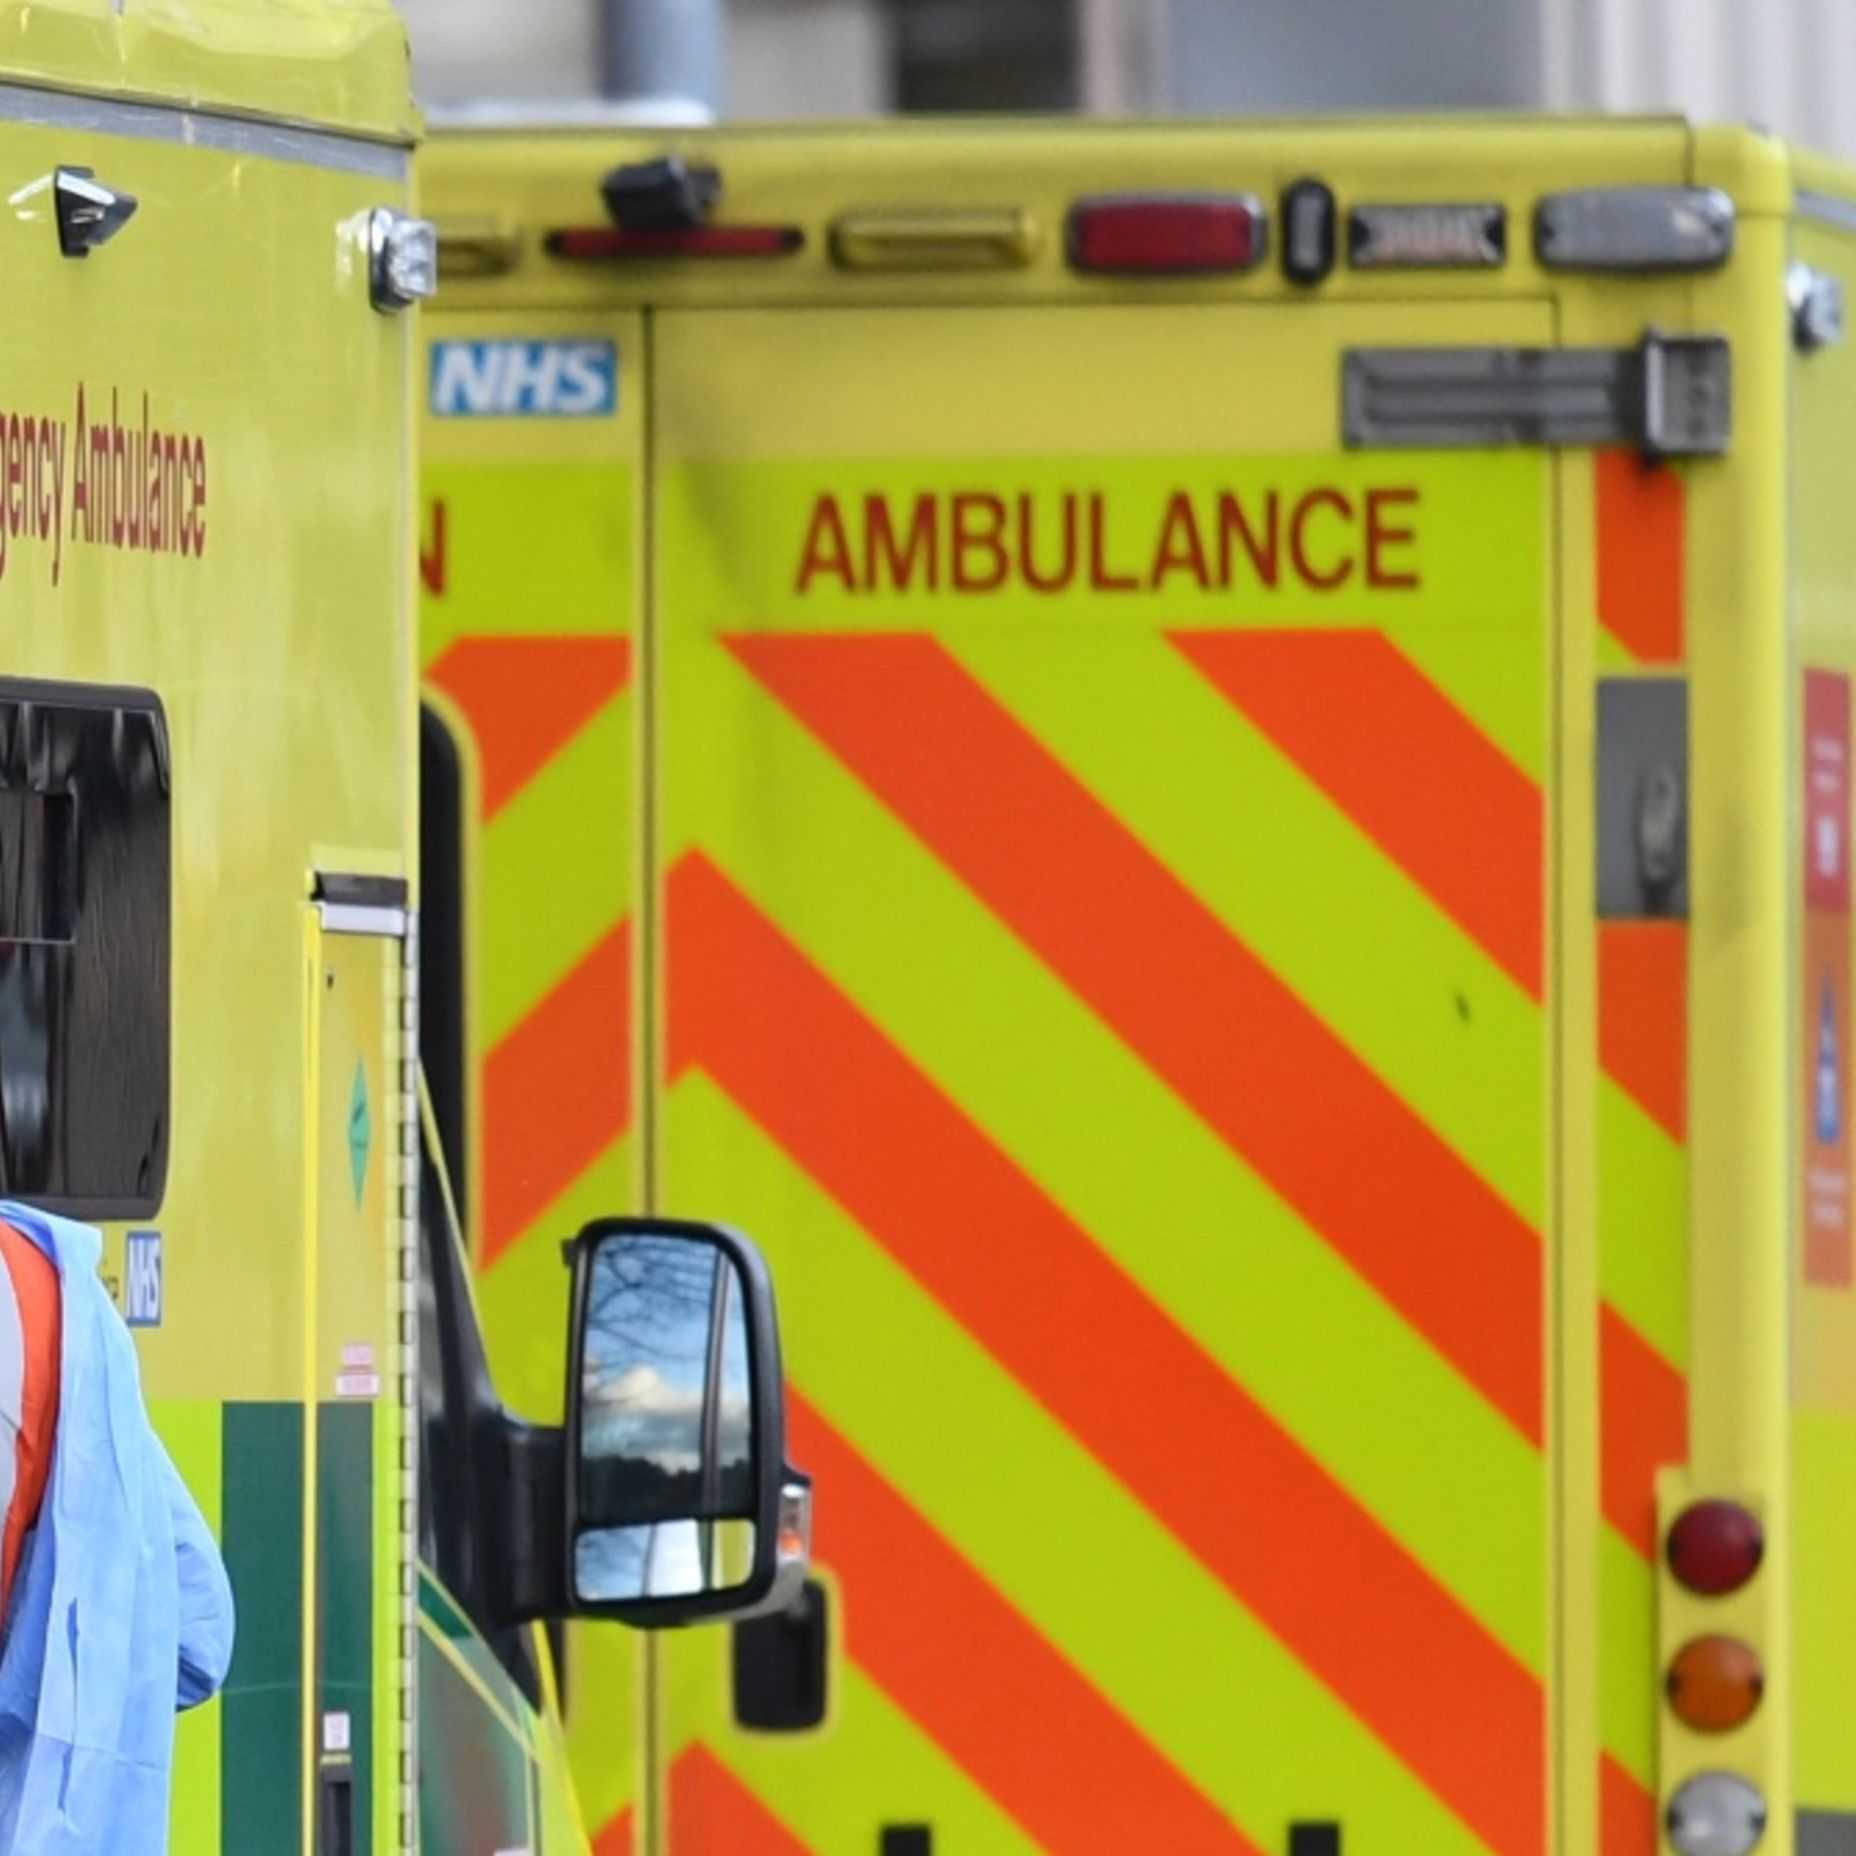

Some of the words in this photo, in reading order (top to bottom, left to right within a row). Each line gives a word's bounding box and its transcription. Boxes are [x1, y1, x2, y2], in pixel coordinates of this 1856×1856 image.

[432, 341, 610, 415] NHS
[71, 380, 206, 560] Ambulance
[793, 483, 1421, 595] AMBULANCE
